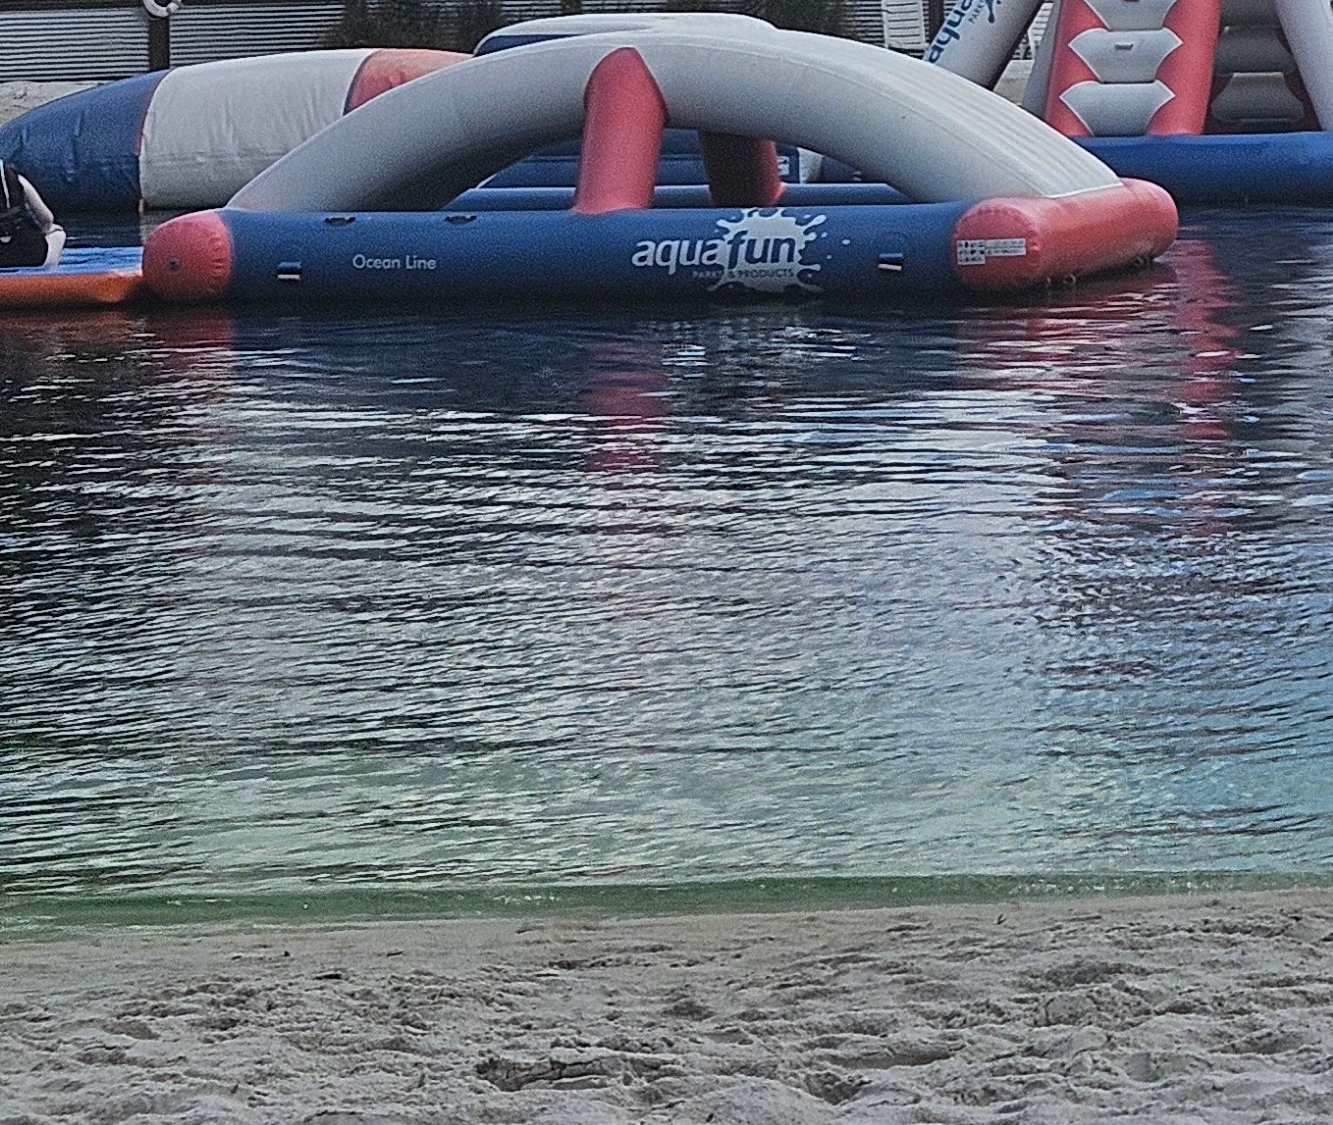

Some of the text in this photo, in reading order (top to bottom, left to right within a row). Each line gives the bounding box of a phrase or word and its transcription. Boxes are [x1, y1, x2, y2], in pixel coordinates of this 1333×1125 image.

[352, 254, 437, 269] Ocean Line
[631, 230, 796, 275] aquafun
